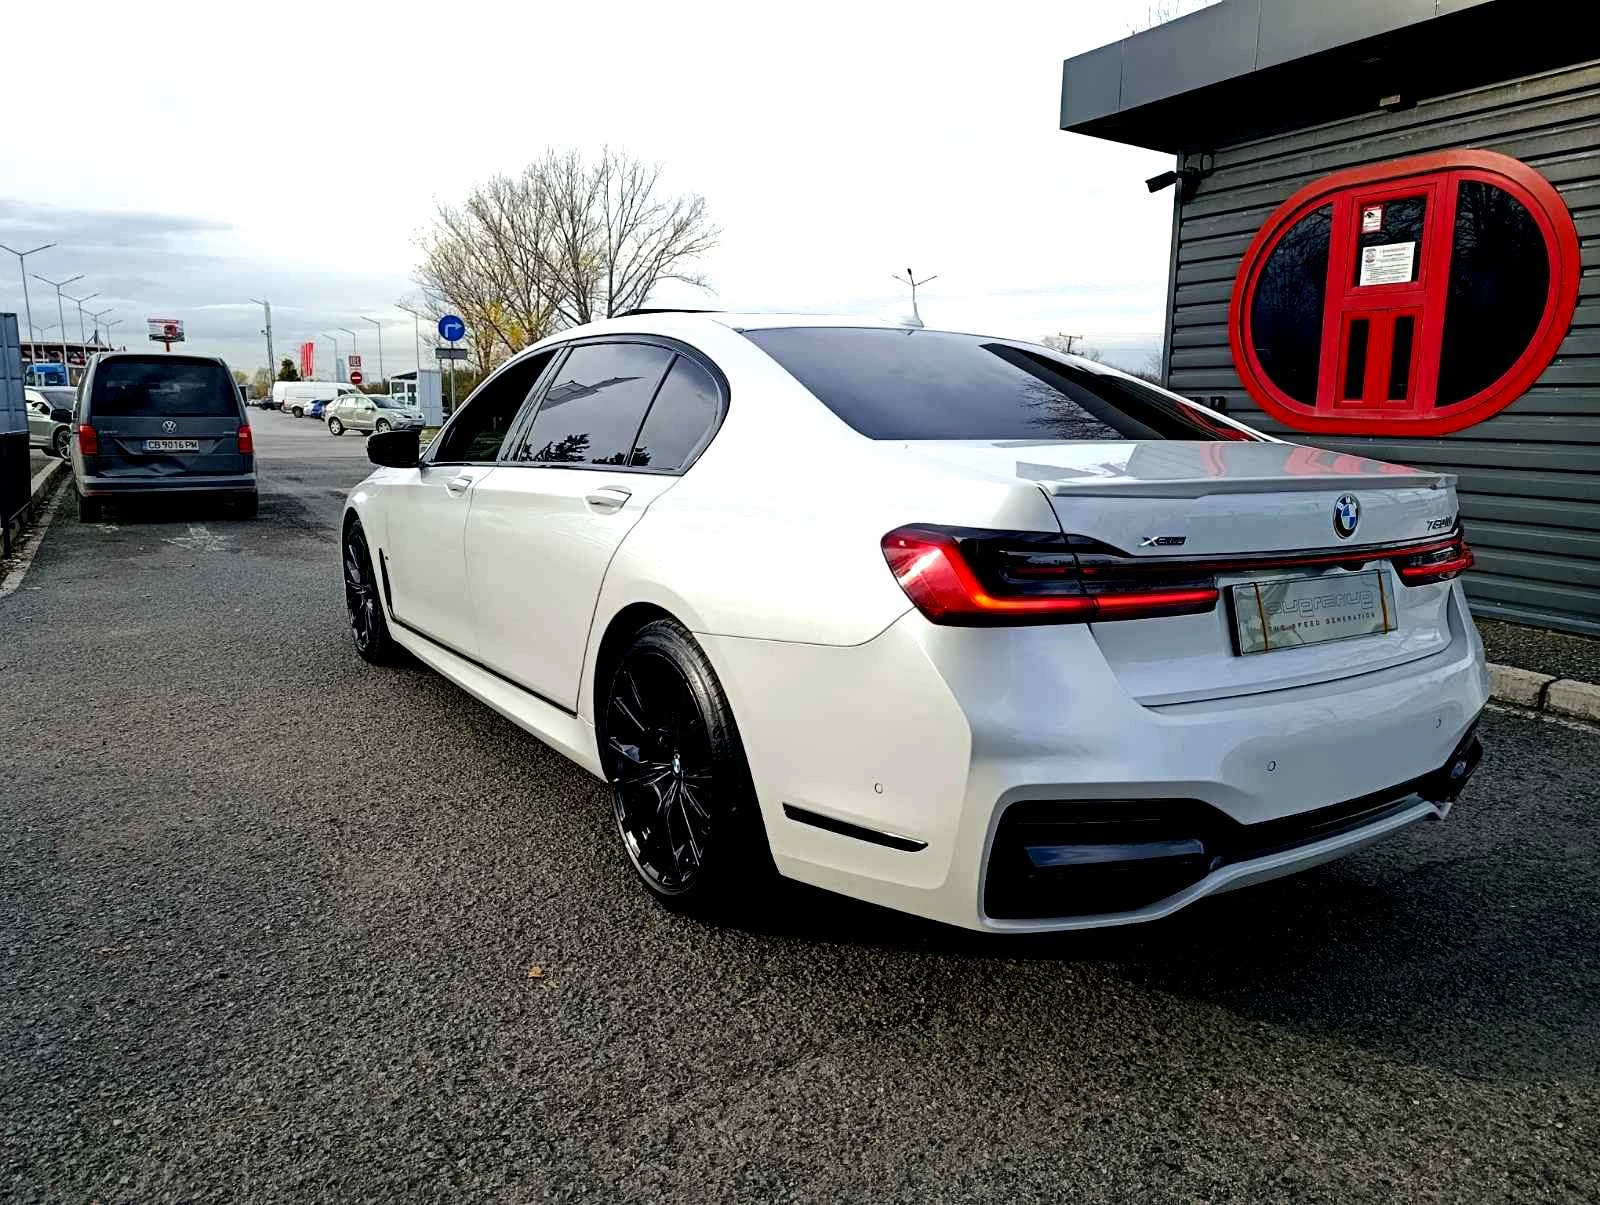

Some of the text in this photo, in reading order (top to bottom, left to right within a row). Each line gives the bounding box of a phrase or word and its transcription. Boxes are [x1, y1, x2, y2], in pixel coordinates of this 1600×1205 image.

[148, 441, 198, 449] CB 9016 PM
